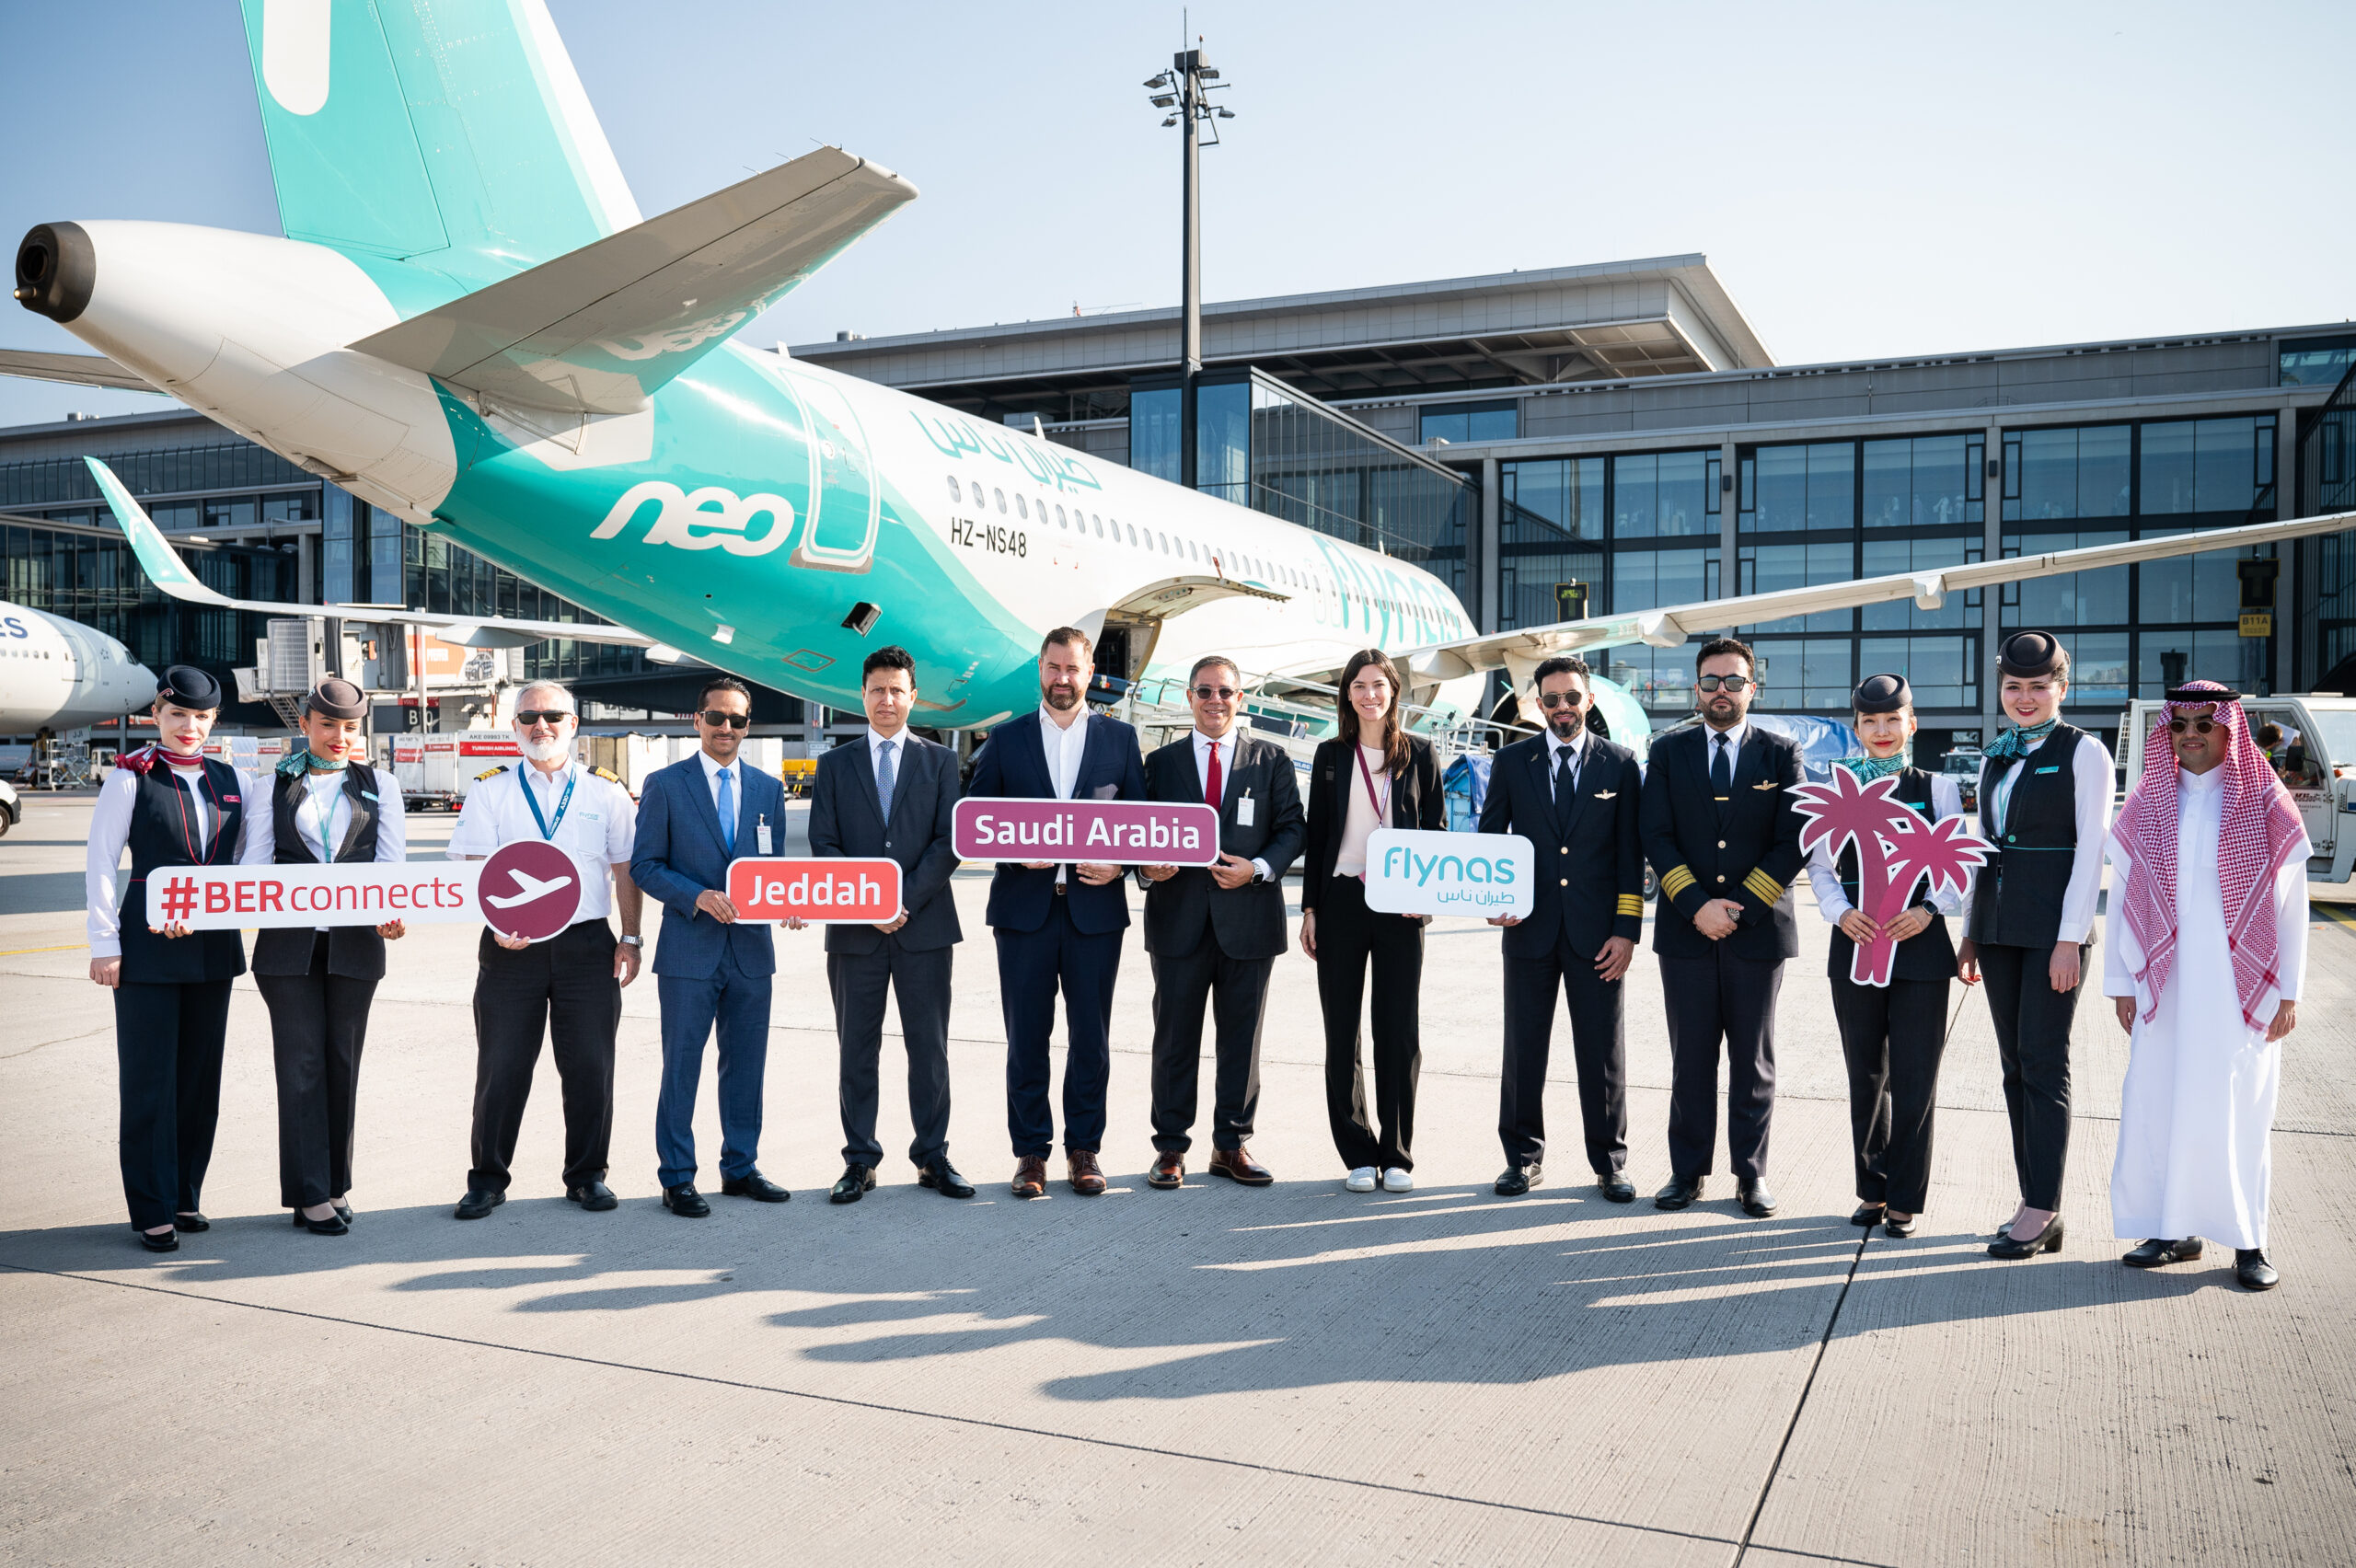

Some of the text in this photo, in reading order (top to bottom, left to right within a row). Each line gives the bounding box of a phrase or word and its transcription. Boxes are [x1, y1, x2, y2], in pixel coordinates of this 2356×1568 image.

[908, 409, 1103, 494] طيران ناس
[590, 480, 795, 558] neo
[951, 516, 1027, 558] HZ-NS48
[2242, 617, 2269, 626] B11A
[409, 709, 433, 726] B0
[975, 813, 1200, 849] Saudi Arabia
[1383, 846, 1515, 887] flynas
[160, 876, 464, 920] #BERconnects
[748, 872, 881, 906] Jeddah
[1438, 889, 1515, 906] طيران ناس
